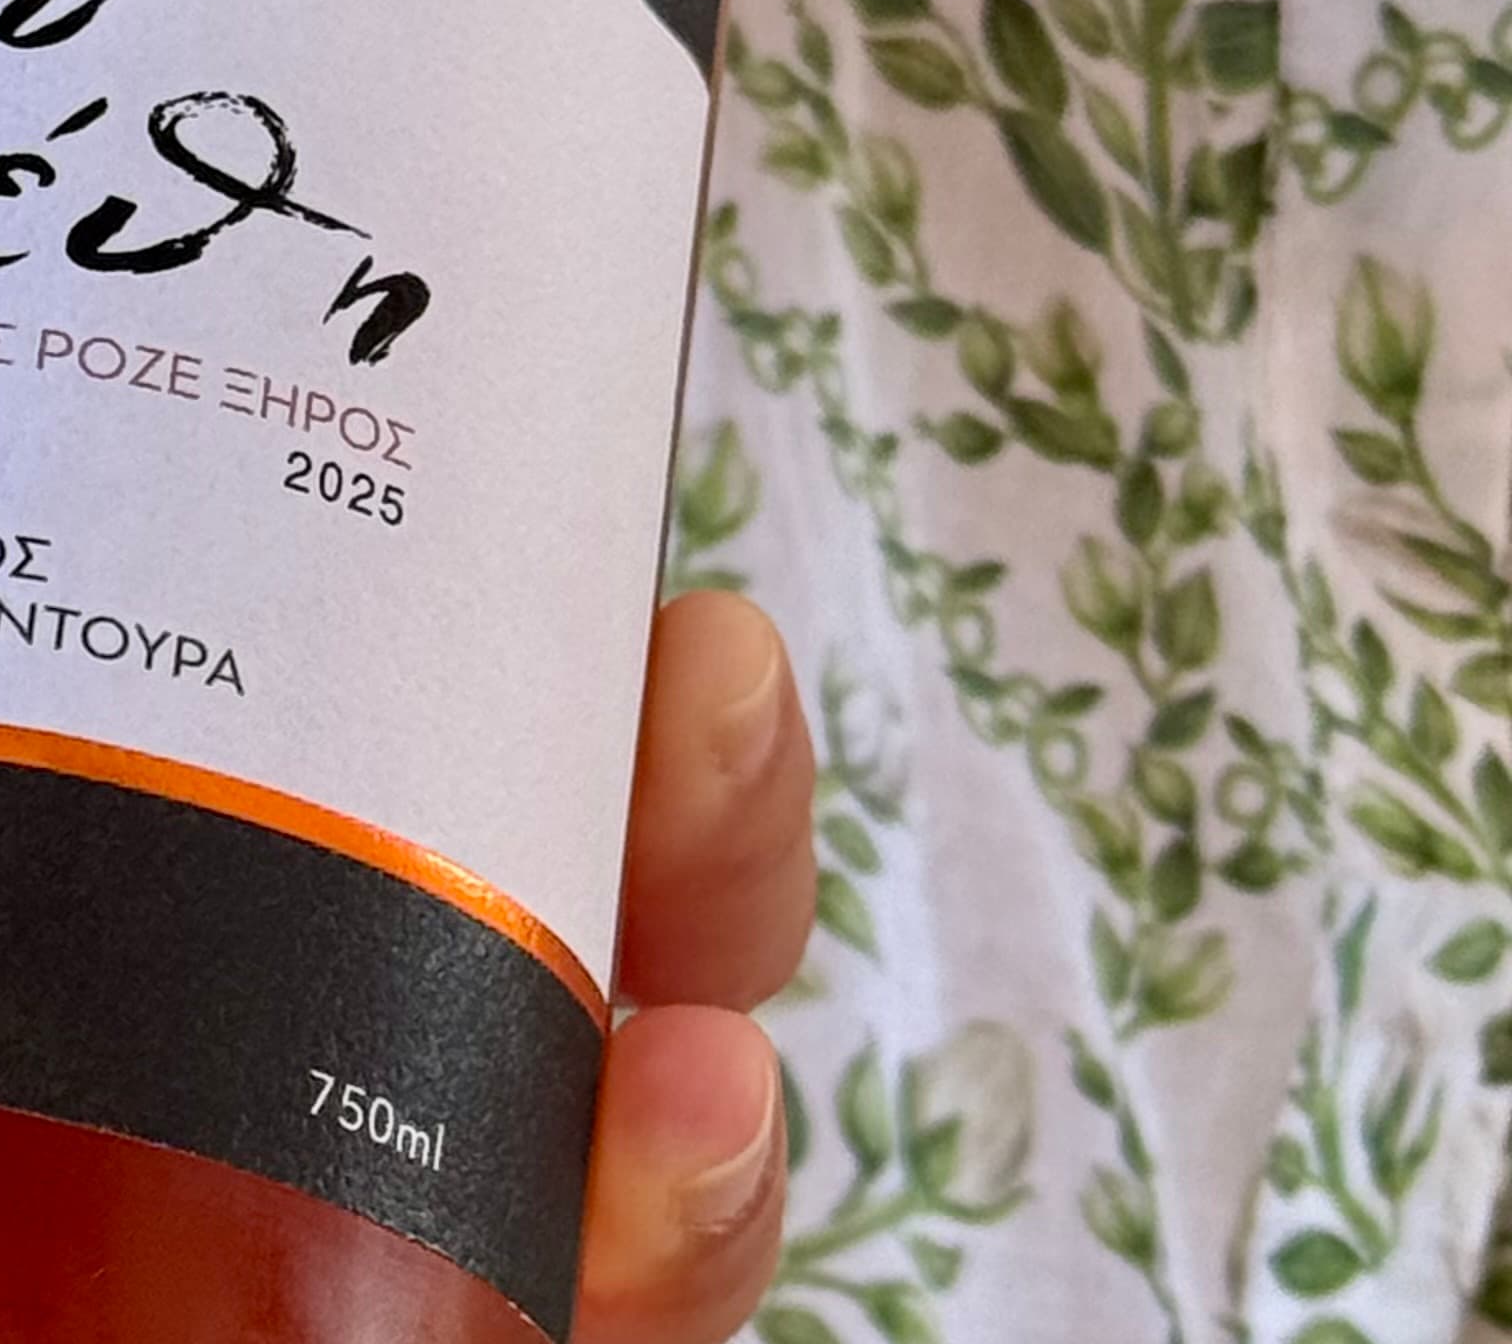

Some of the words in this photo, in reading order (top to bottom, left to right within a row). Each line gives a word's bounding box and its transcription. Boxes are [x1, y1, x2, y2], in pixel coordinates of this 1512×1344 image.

[35, 328, 203, 402] ΡΟΖΕ
[218, 366, 417, 471] ΞΗΡΟΣ
[283, 451, 407, 528] 2025
[308, 1068, 445, 1171] 750ml
